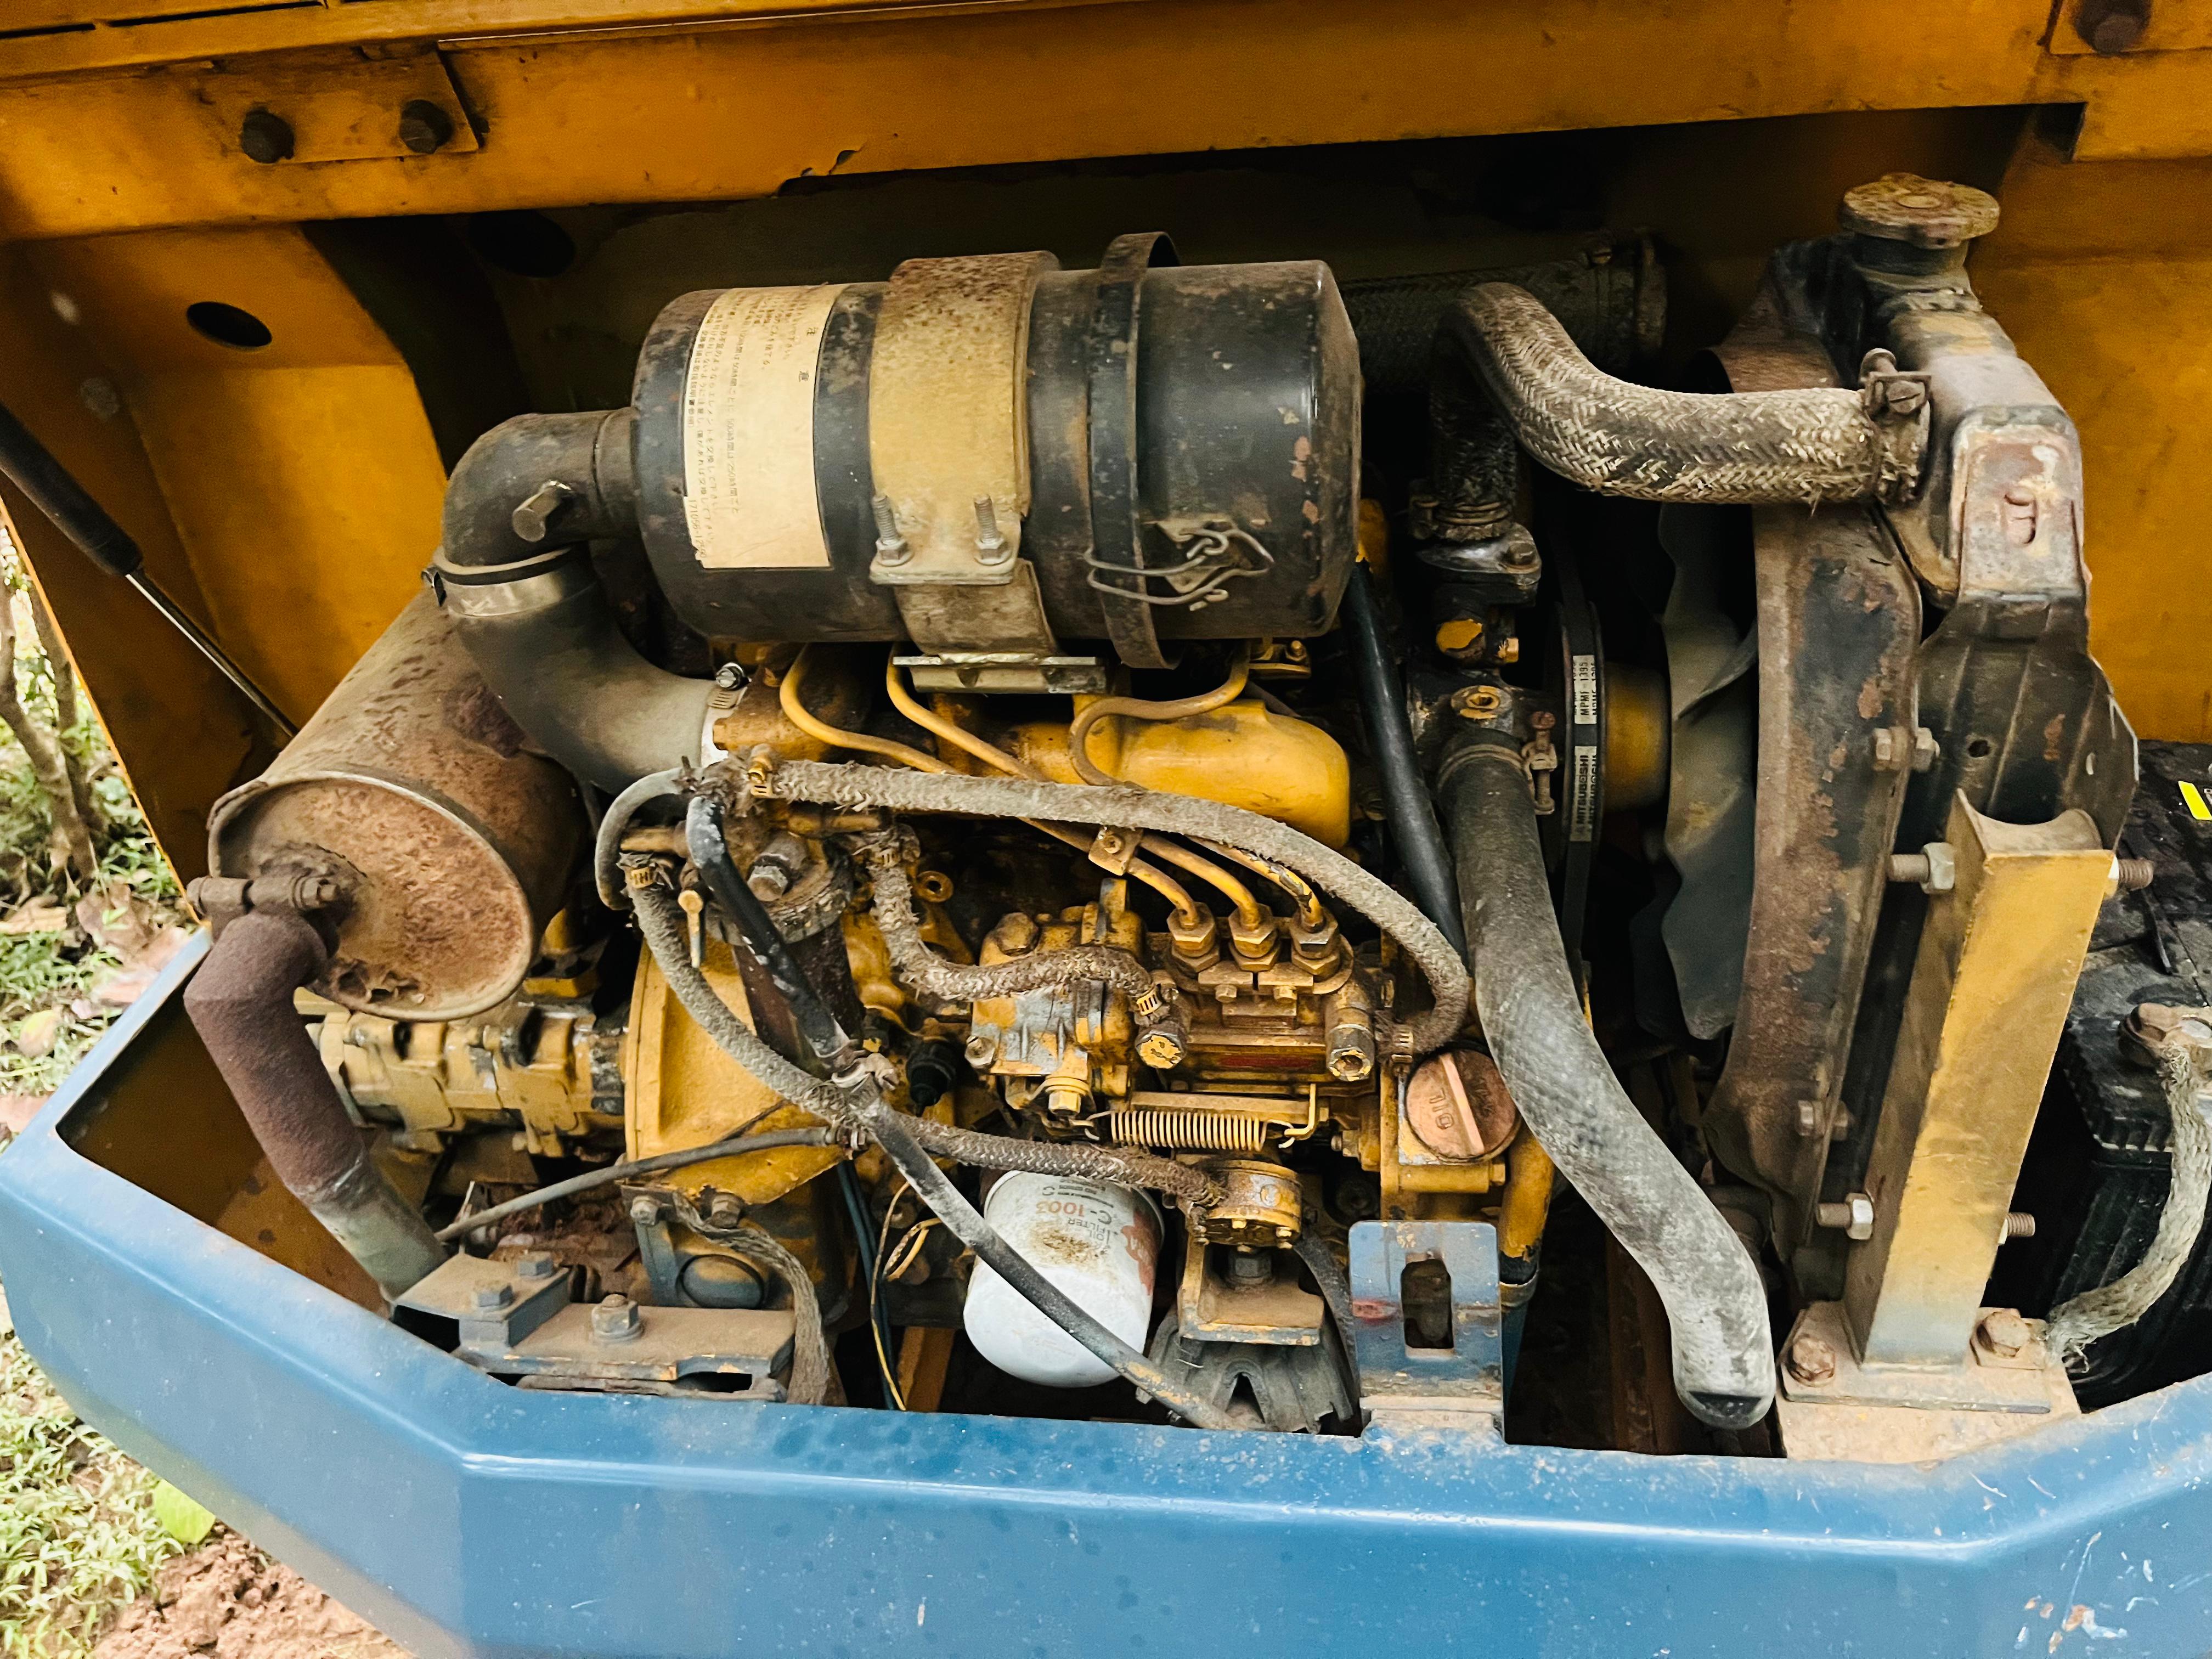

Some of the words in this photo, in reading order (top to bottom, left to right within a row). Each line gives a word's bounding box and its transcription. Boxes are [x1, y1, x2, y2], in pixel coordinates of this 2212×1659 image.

[1429, 1088, 1454, 1130] OIL
[1068, 1217, 1105, 1234] FILTER
[1087, 1228, 1105, 1242] OIL
